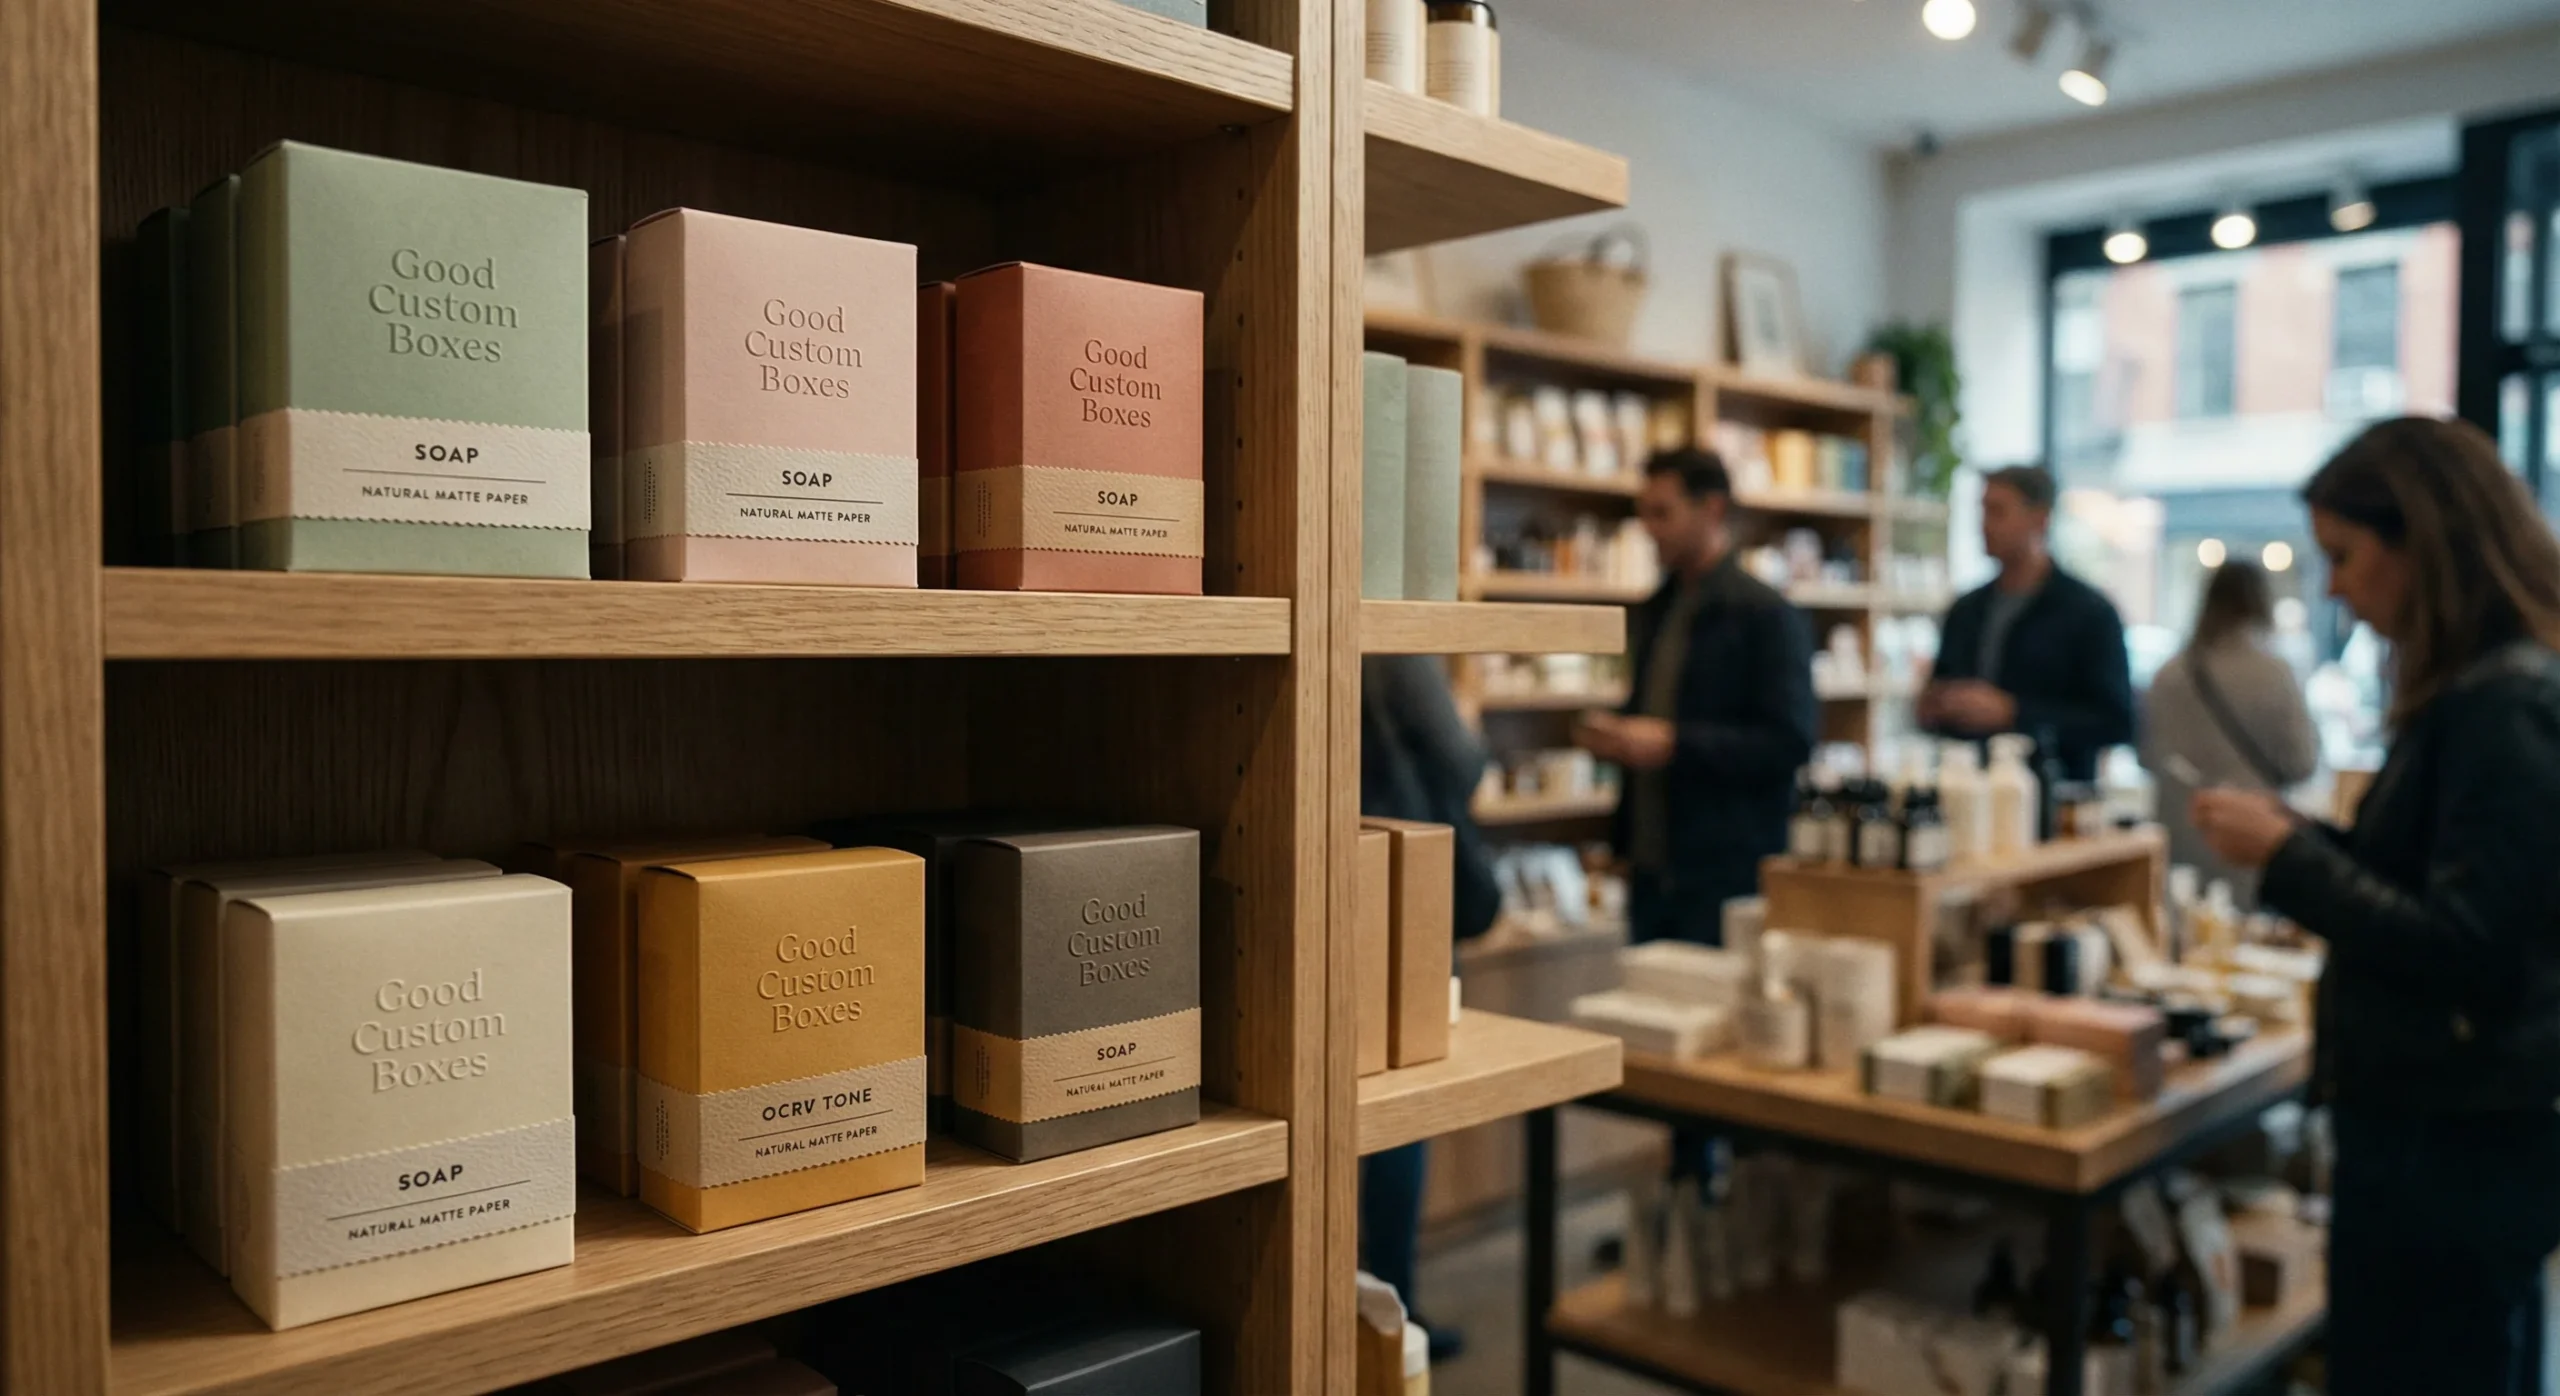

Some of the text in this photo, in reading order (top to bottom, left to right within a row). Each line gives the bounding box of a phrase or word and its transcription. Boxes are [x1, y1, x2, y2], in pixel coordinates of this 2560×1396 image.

[391, 248, 496, 290] Good
[368, 283, 518, 328] Custom
[764, 298, 845, 334] Good
[387, 322, 502, 363] Boxes
[745, 330, 862, 368] Custom
[1085, 339, 1147, 370] Good
[760, 364, 850, 399] Boxes
[1070, 367, 1161, 400] Custom
[1081, 397, 1151, 428] Boxes
[415, 443, 479, 464] SOAP
[362, 485, 528, 505] NATURAL MATTE PAPER
[782, 470, 832, 487] SOAP
[1097, 490, 1138, 506] SOAP
[740, 507, 871, 523] NATURAL MATTE PAPER
[1064, 524, 1106, 535] NATURAL
[1110, 527, 1138, 537] MATTE
[1082, 891, 1147, 925] Good
[776, 925, 857, 963] Good
[1068, 926, 1161, 958] Custom
[757, 964, 875, 1000] Custom
[1080, 957, 1151, 987] Boxes
[376, 968, 483, 1013] Good
[772, 1000, 862, 1033] Boxes
[352, 1013, 506, 1056] Custom
[1097, 1042, 1137, 1060] SOAP
[372, 1052, 488, 1094] Boxes
[1109, 1075, 1136, 1088] MATTE
[762, 1088, 872, 1121] OCRV TONE
[755, 1125, 877, 1158] NATURAL MATTE PAPER
[398, 1164, 463, 1191] SOAP
[348, 1199, 510, 1240] NATURAL MATTE PAPER
